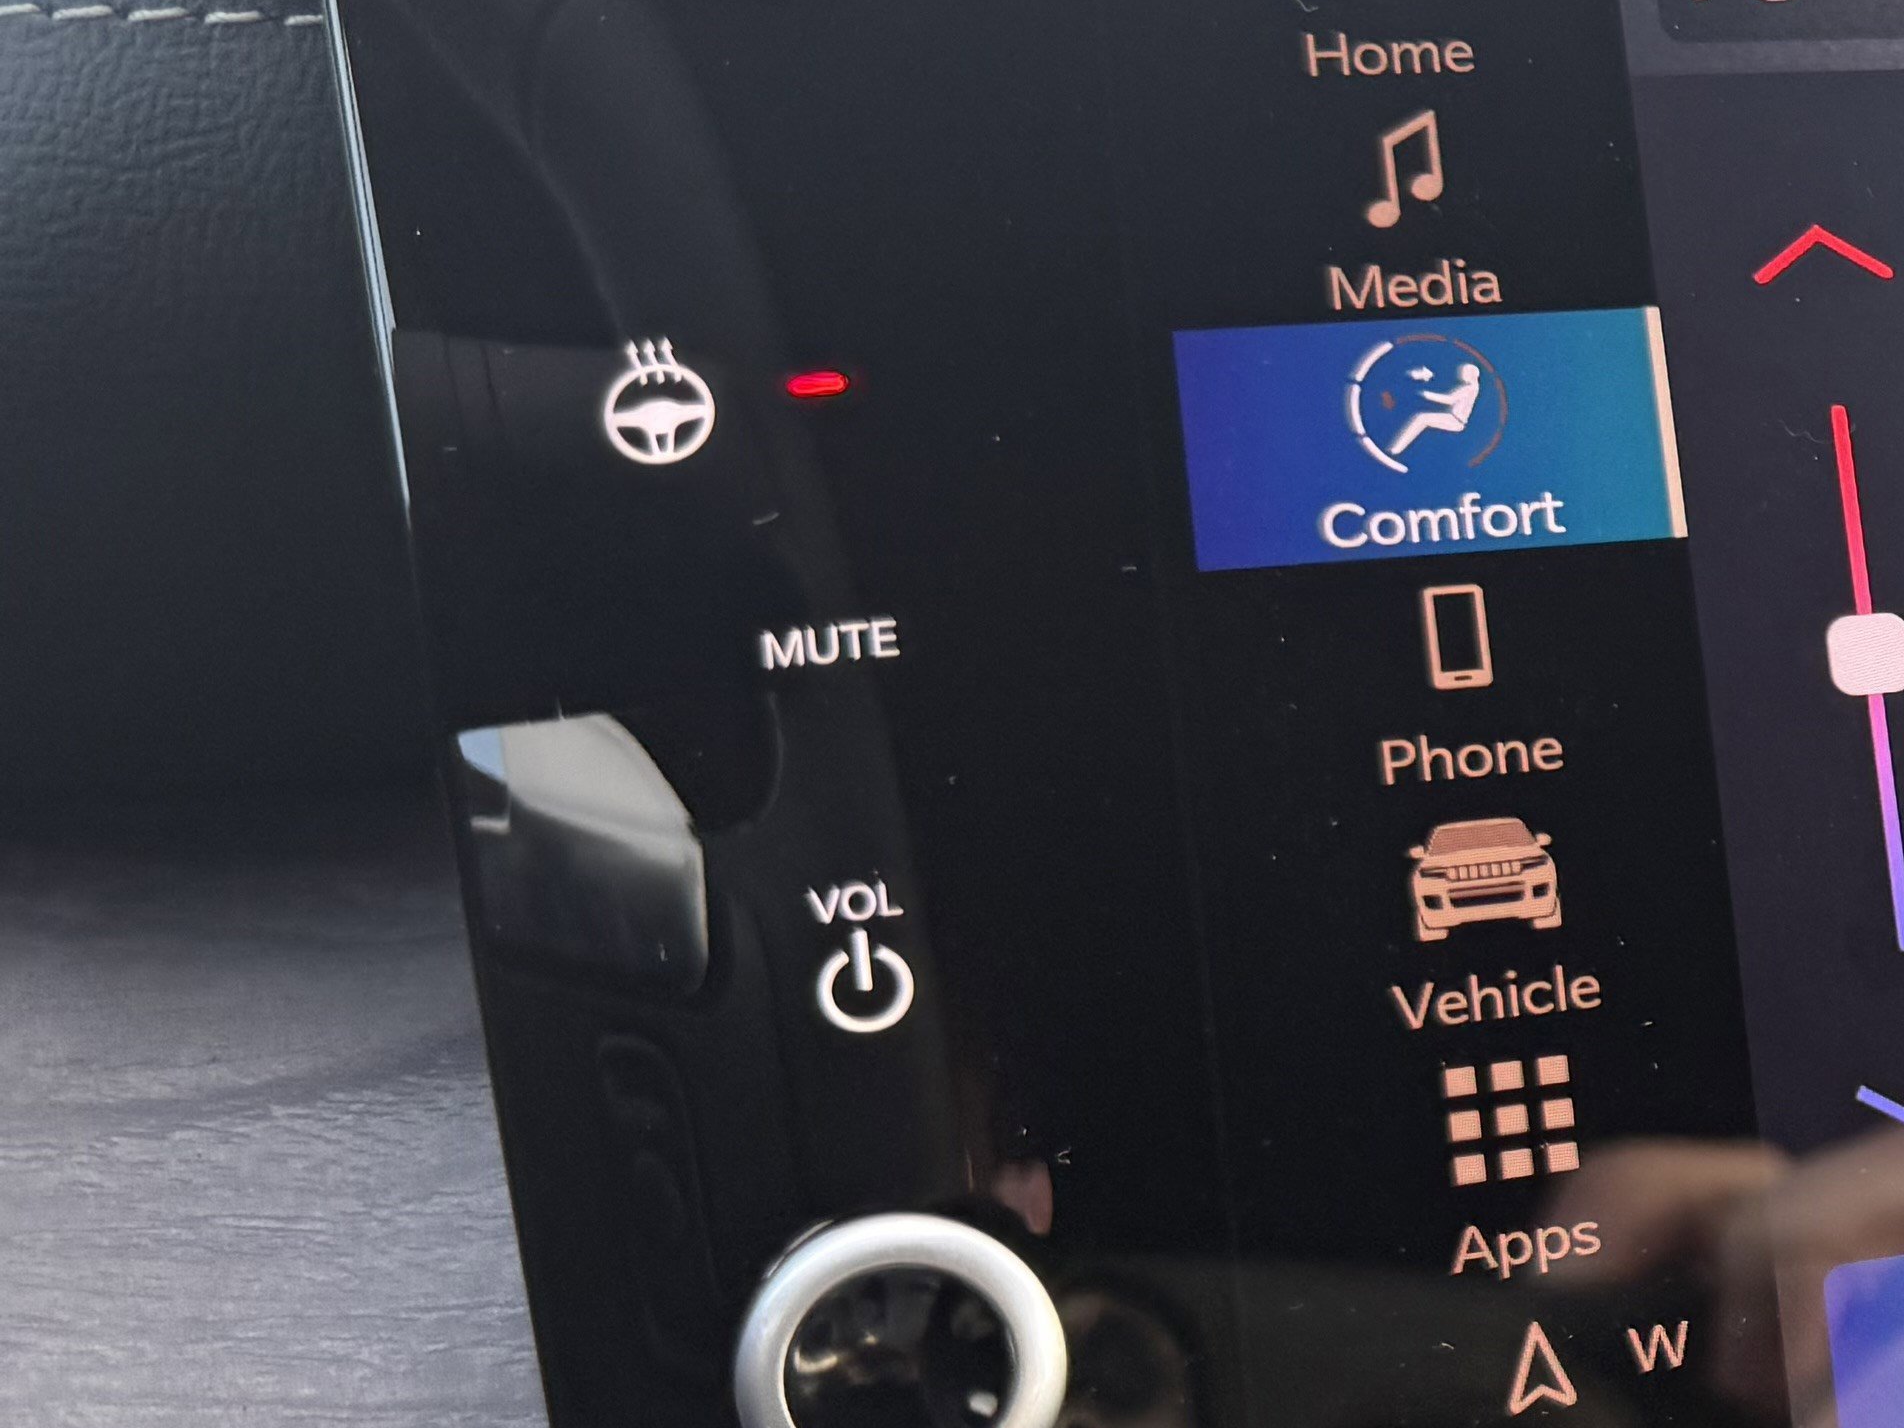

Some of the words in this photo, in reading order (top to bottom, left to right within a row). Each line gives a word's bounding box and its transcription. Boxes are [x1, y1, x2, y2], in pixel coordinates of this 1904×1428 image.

[1305, 32, 1475, 77] Home
[1327, 259, 1503, 310] Media
[1318, 490, 1567, 549] Comfort
[760, 616, 901, 671] MUTE
[1379, 730, 1565, 786] Phone
[806, 881, 904, 924] VOL
[1391, 965, 1602, 1031] Vehicle
[1449, 1213, 1602, 1280] Apps
[1626, 1319, 1690, 1375] W
